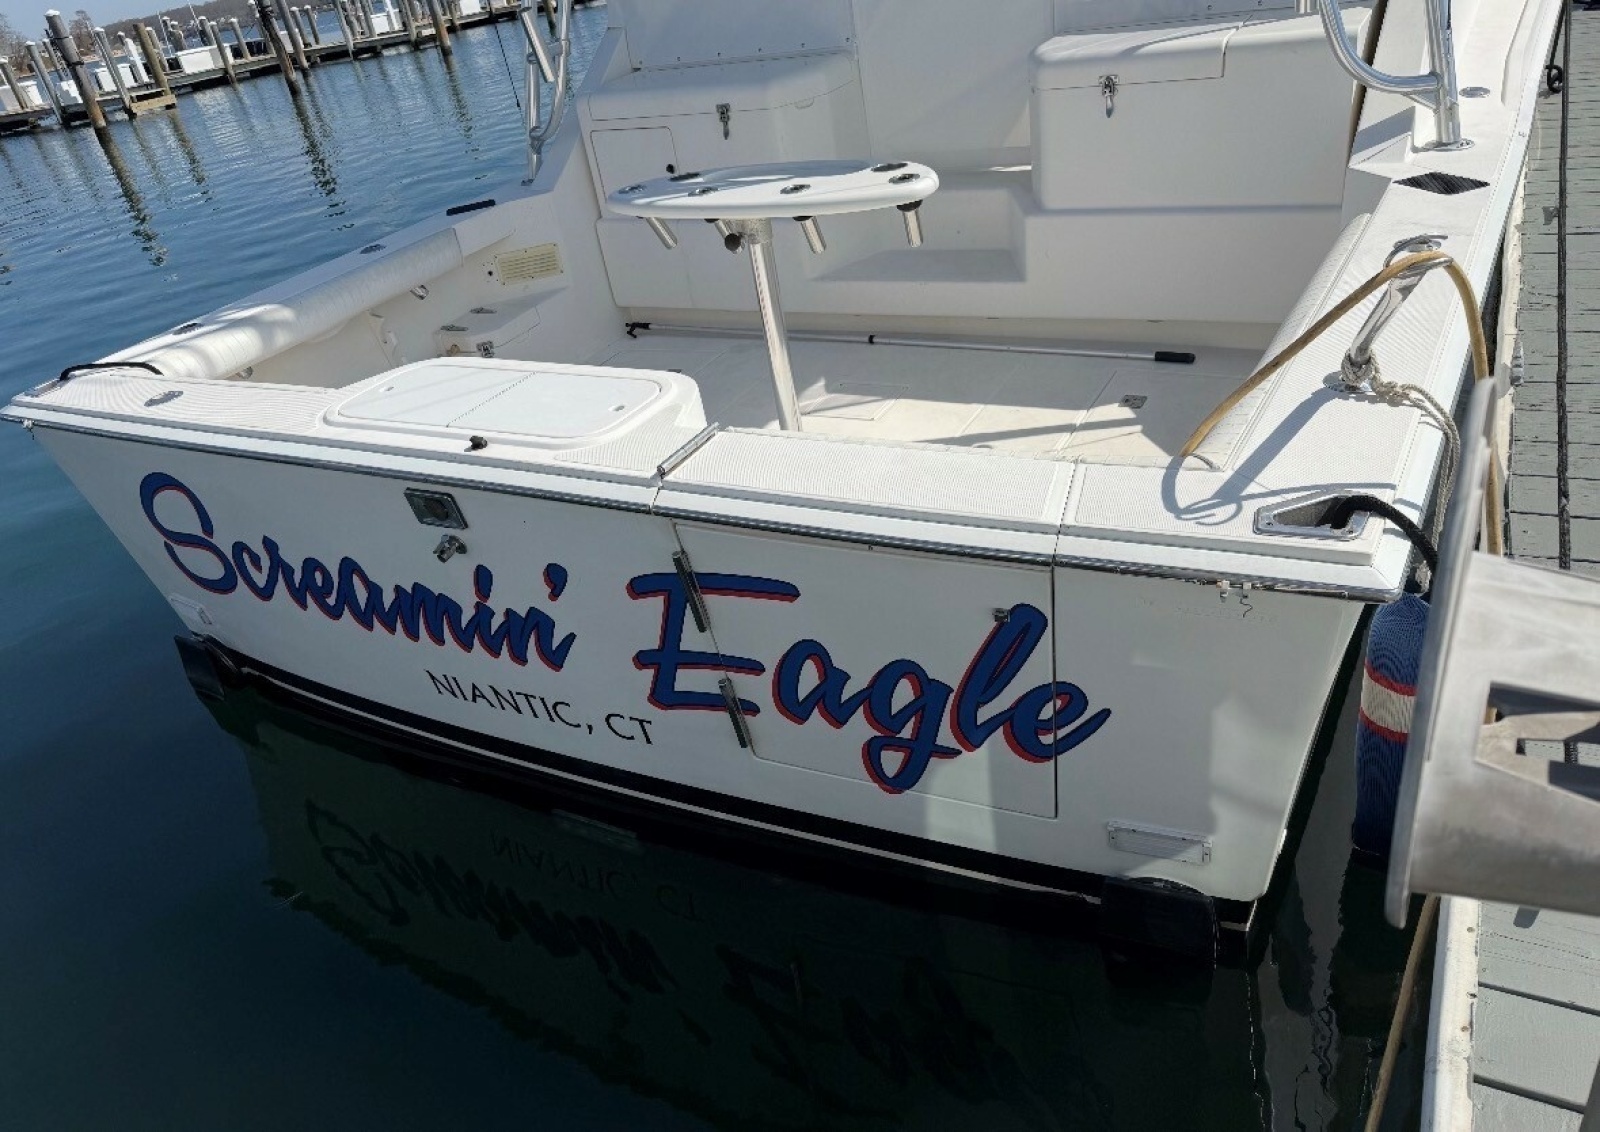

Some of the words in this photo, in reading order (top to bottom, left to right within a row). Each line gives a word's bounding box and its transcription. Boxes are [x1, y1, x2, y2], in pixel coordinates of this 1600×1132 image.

[139, 471, 577, 672] Screamin'
[626, 572, 1112, 795] Eagle
[424, 668, 593, 735] NIANTIC,
[604, 713, 653, 745] CT
